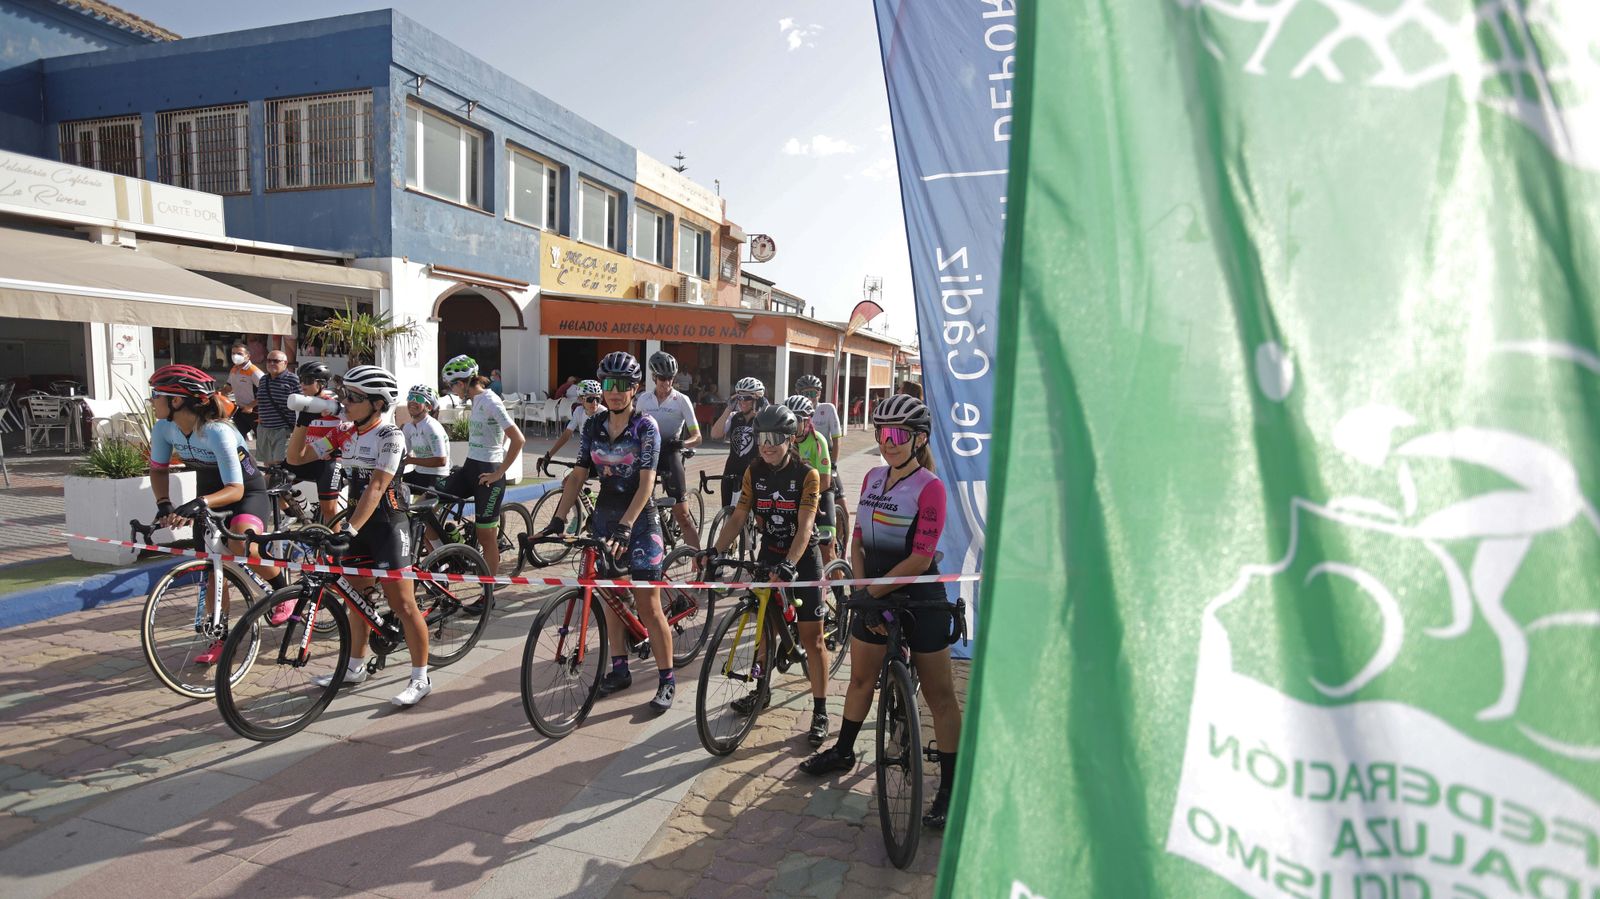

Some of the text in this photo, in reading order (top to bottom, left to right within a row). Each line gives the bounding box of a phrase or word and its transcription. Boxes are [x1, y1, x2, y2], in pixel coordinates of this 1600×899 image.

[28, 184, 86, 206] Rivera
[157, 201, 221, 223] CARTE D'OR
[683, 325, 696, 336] LO
[336, 574, 384, 627] Bianchi
[301, 601, 317, 649] Bianchi
